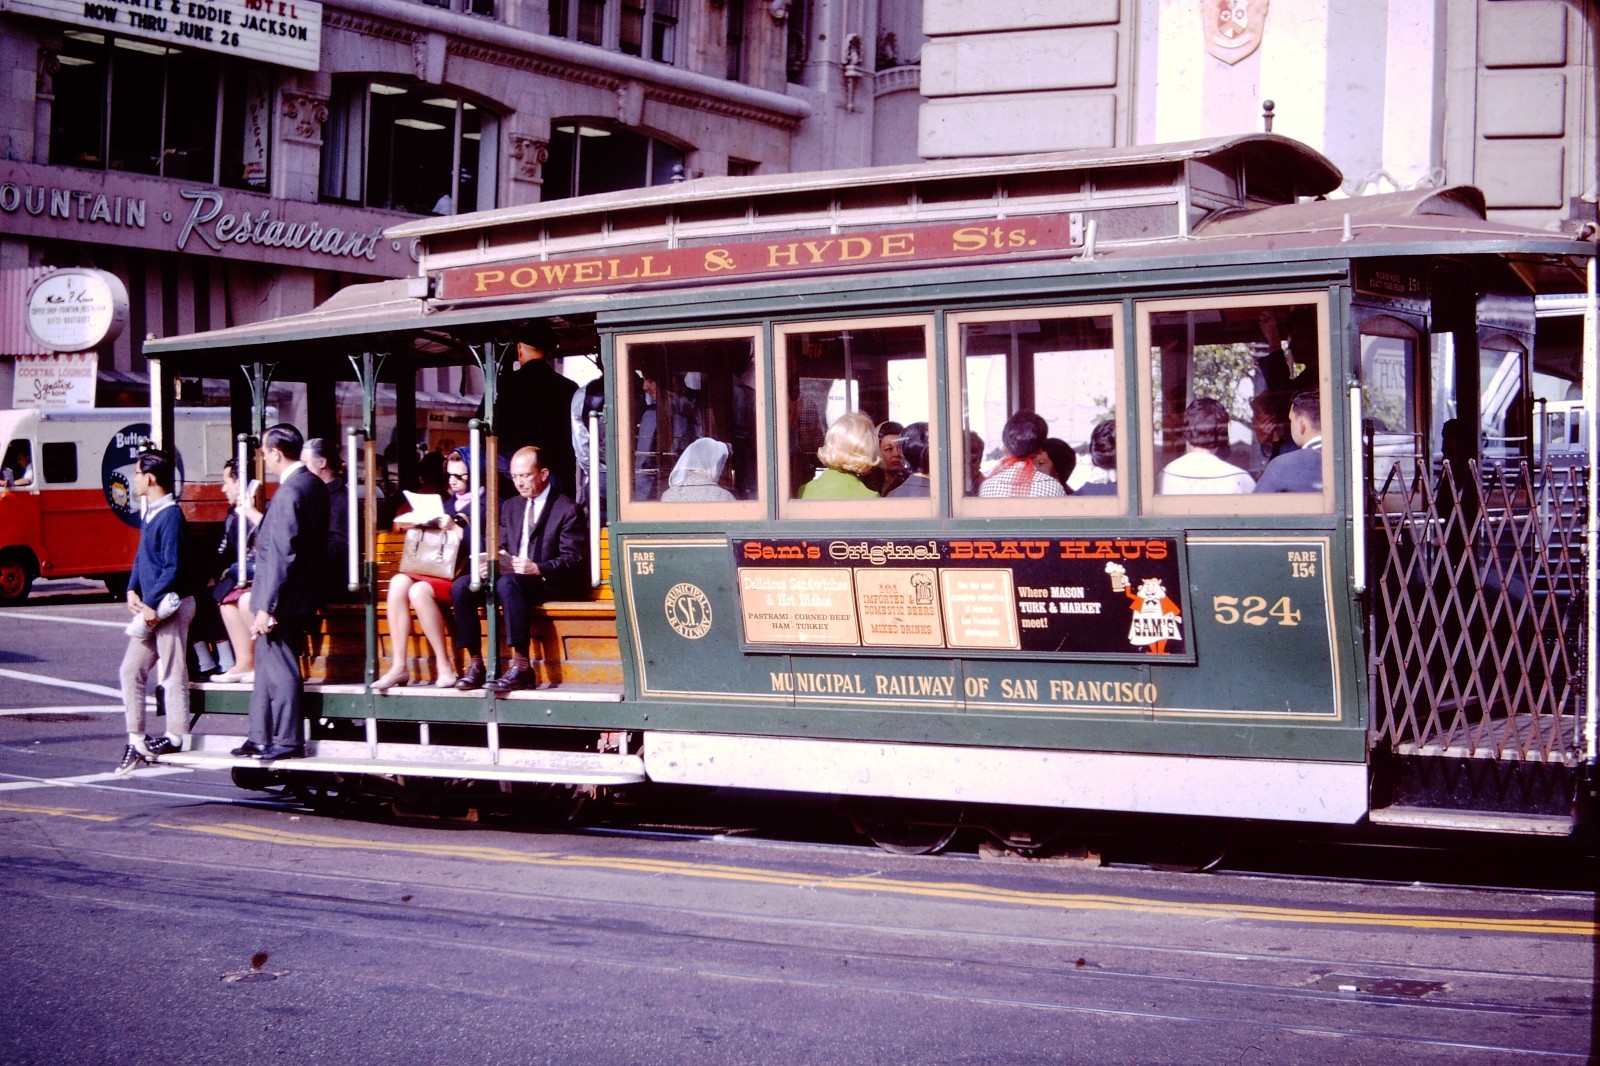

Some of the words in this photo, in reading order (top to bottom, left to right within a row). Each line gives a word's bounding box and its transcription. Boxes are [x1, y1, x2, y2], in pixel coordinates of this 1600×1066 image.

[245, 0, 298, 19] HOTEL
[84, 2, 117, 22] NOW
[129, 12, 167, 32] THRU
[174, 21, 213, 42] JUNE
[221, 30, 239, 47] 26
[171, 0, 183, 14] &
[188, 2, 232, 25] EDDIE
[240, 15, 307, 41] JACKSON
[0, 182, 145, 228] OUNTAIN
[177, 188, 383, 261] Restaurant
[474, 256, 671, 292] POWELL
[704, 249, 736, 271] &
[768, 232, 915, 267] HYDE
[952, 226, 1037, 251] Sts.
[19, 368, 54, 376] COCKTAIL
[59, 368, 92, 377] LOUNGE
[633, 552, 655, 561] FARE
[744, 541, 820, 559] Sam's
[829, 541, 940, 564] Original
[950, 541, 1049, 559] BRAU
[1060, 541, 1168, 560] HAUS
[1288, 551, 1317, 562] FARE
[636, 562, 654, 575] 15¢
[1292, 563, 1315, 577] 15¢
[668, 585, 706, 608] MUNICIPAL
[863, 595, 905, 604] IMPORTED
[1018, 587, 1048, 598] Where
[1050, 587, 1084, 599] MASON
[864, 606, 904, 615] DOMESTIC
[907, 606, 934, 616] BEERS
[1019, 602, 1047, 613] TURK
[1049, 603, 1058, 613] &
[1060, 603, 1102, 614] MARKET
[1213, 595, 1301, 626] 524
[670, 616, 710, 637] RAILWAY
[870, 624, 898, 634] MIXED
[900, 624, 932, 634] DRINKS
[1021, 618, 1048, 628] meet!
[1134, 618, 1175, 637] SAM'S
[770, 672, 865, 694] MUNICIPAL
[875, 675, 955, 696] RAILWAY
[964, 677, 989, 698] OF
[1001, 678, 1038, 700] SAN
[1050, 680, 1157, 703] FRANCISCO
